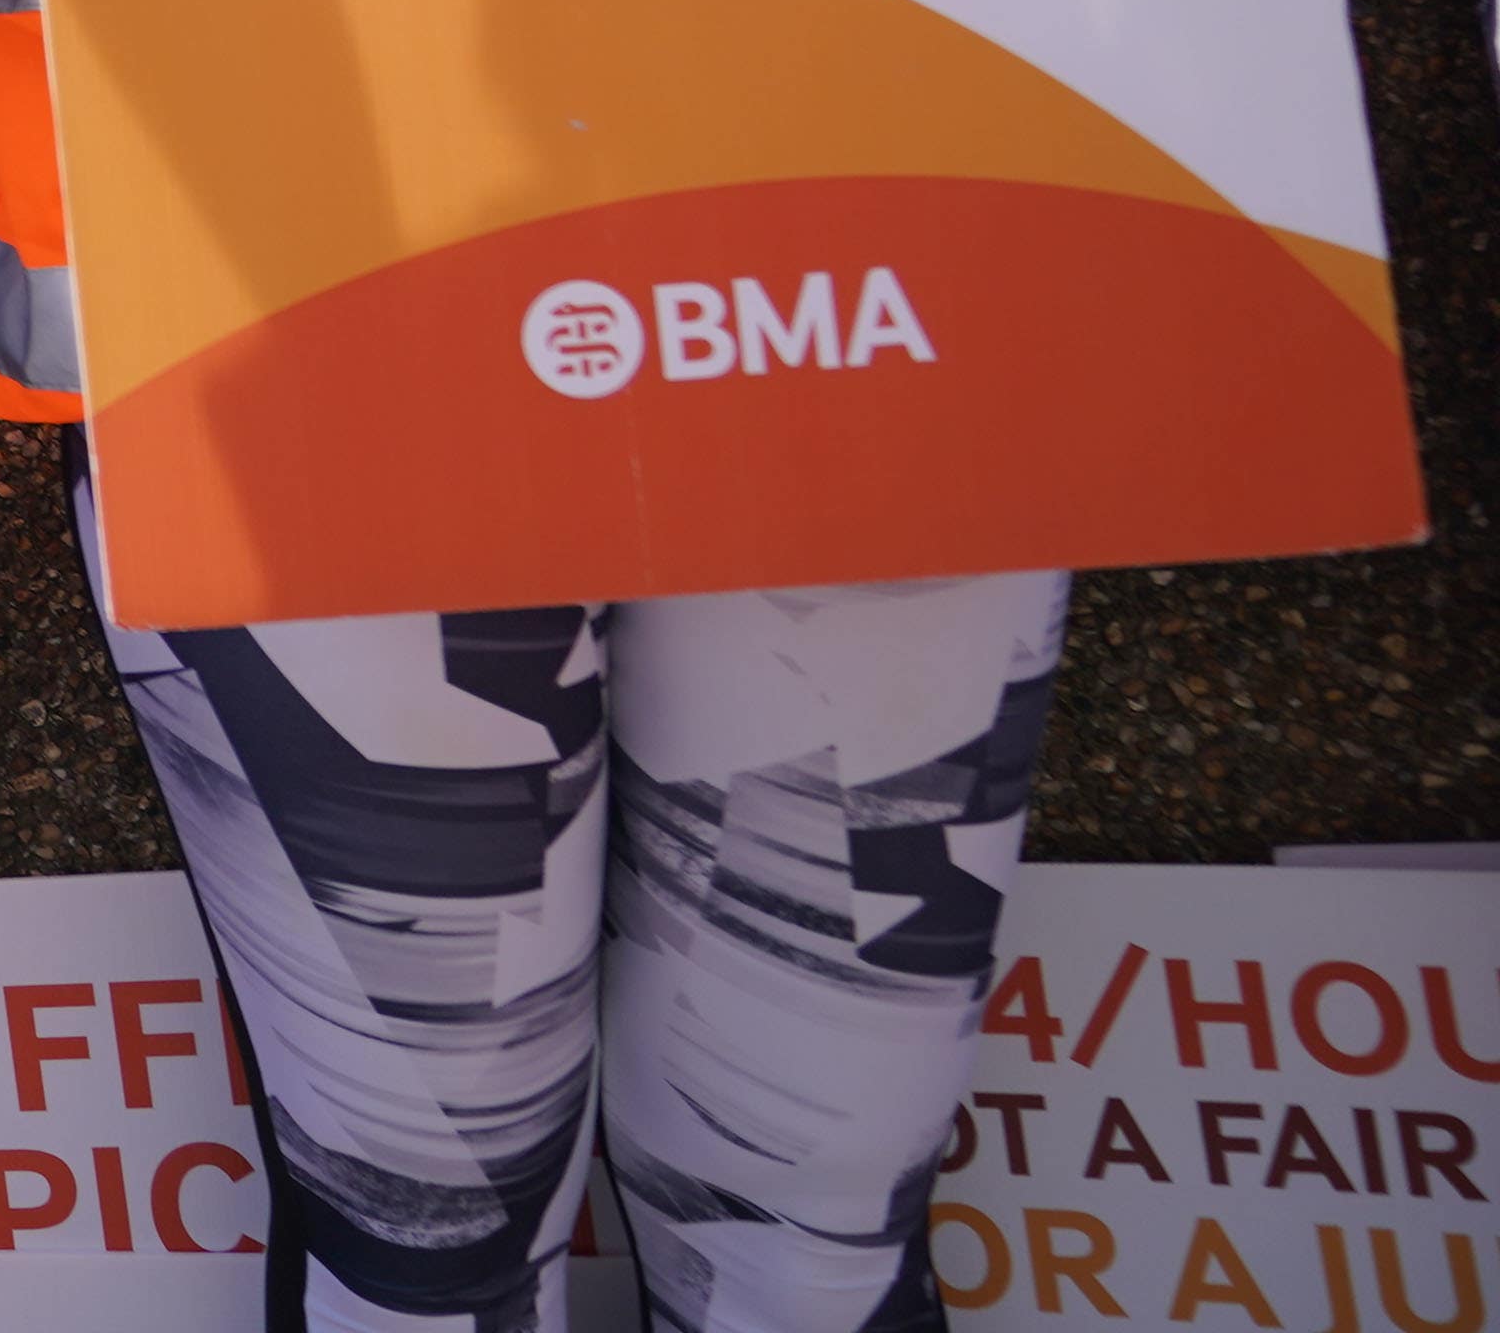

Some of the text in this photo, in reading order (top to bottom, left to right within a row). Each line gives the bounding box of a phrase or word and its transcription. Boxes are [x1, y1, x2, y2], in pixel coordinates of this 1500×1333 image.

[655, 268, 934, 380] BMA
[1083, 1096, 1173, 1183] A
[1196, 1100, 1490, 1202] FAIR
[1168, 1217, 1286, 1329] A
[1310, 1223, 1500, 1333] JU
